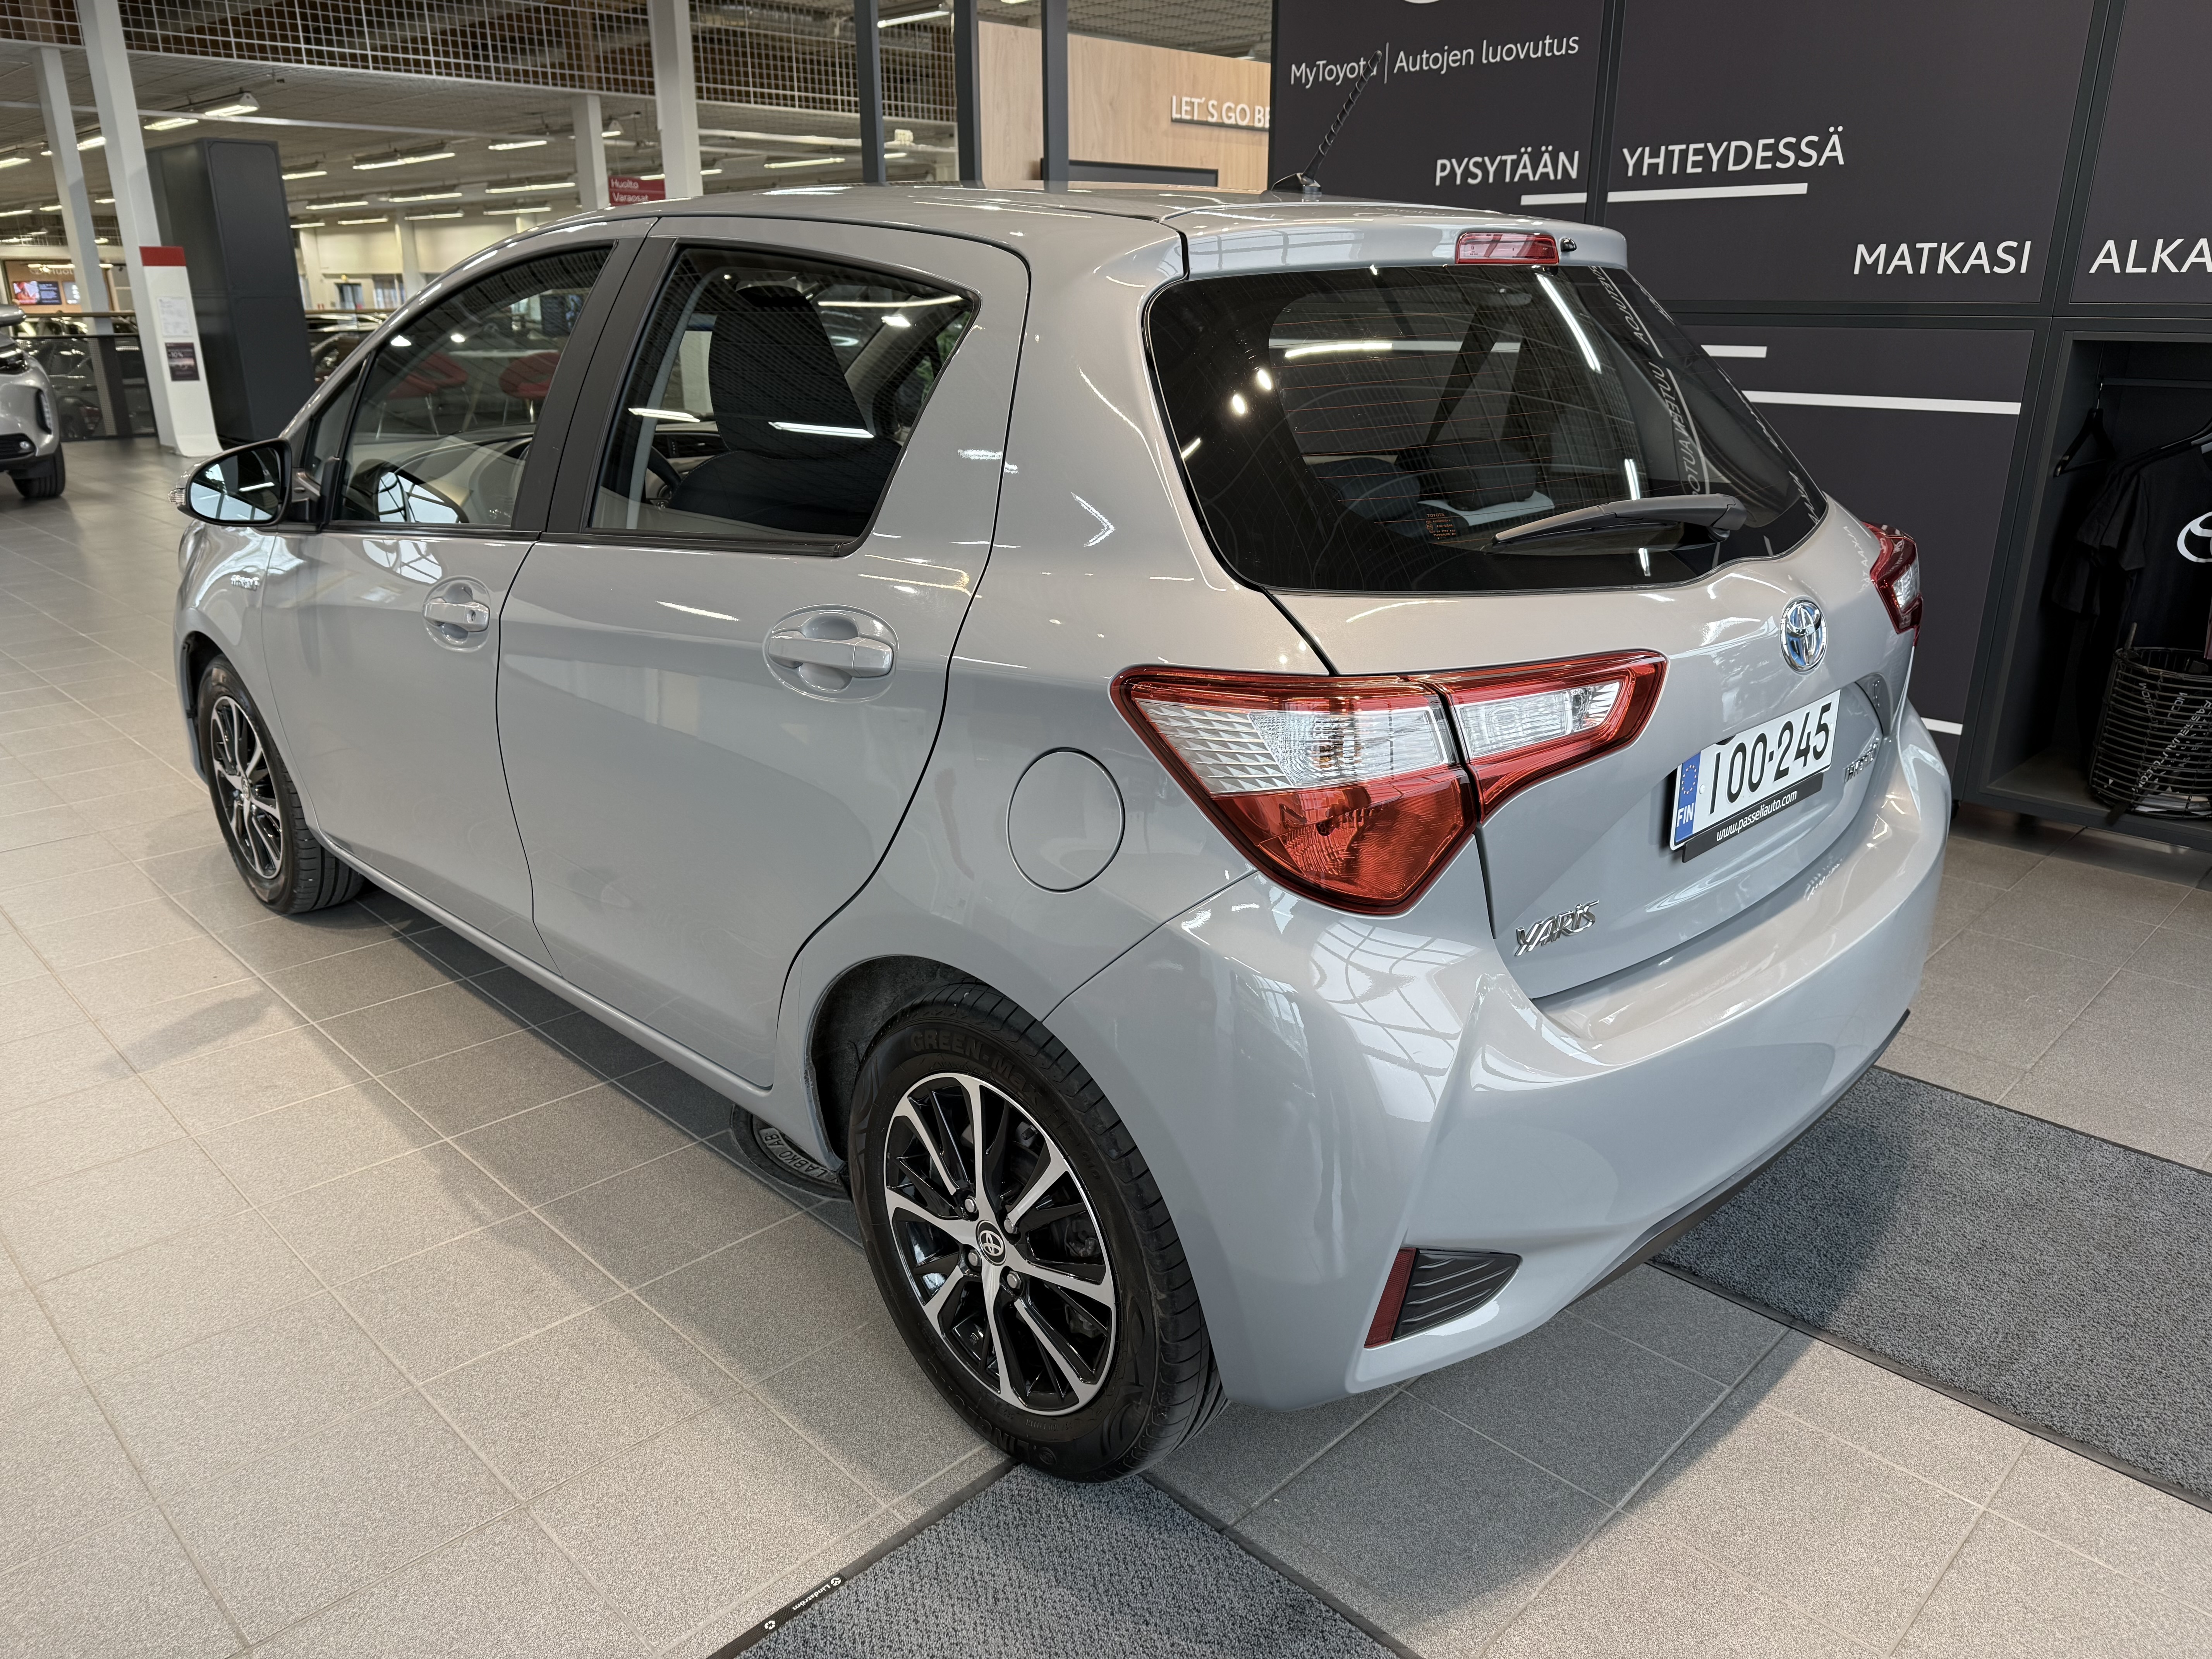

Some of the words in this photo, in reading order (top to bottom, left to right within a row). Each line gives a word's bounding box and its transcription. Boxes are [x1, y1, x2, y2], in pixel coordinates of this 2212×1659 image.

[1394, 46, 1474, 74] Autojen
[1482, 35, 1579, 64] luovutus
[1222, 102, 1250, 125] GO
[1436, 146, 1579, 186] PYSYTÄÄN
[1623, 126, 1844, 177] YHTEYDESSÄ
[611, 179, 639, 189] Huolto
[1854, 241, 2032, 274] MATKASI
[2089, 238, 2212, 273] ALKA
[1676, 803, 1695, 828] FIN
[1716, 790, 1797, 842] www.passeliauto.com
[764, 1134, 785, 1146] AB
[779, 1151, 828, 1178] LABKO
[792, 1584, 831, 1611] Lindström
